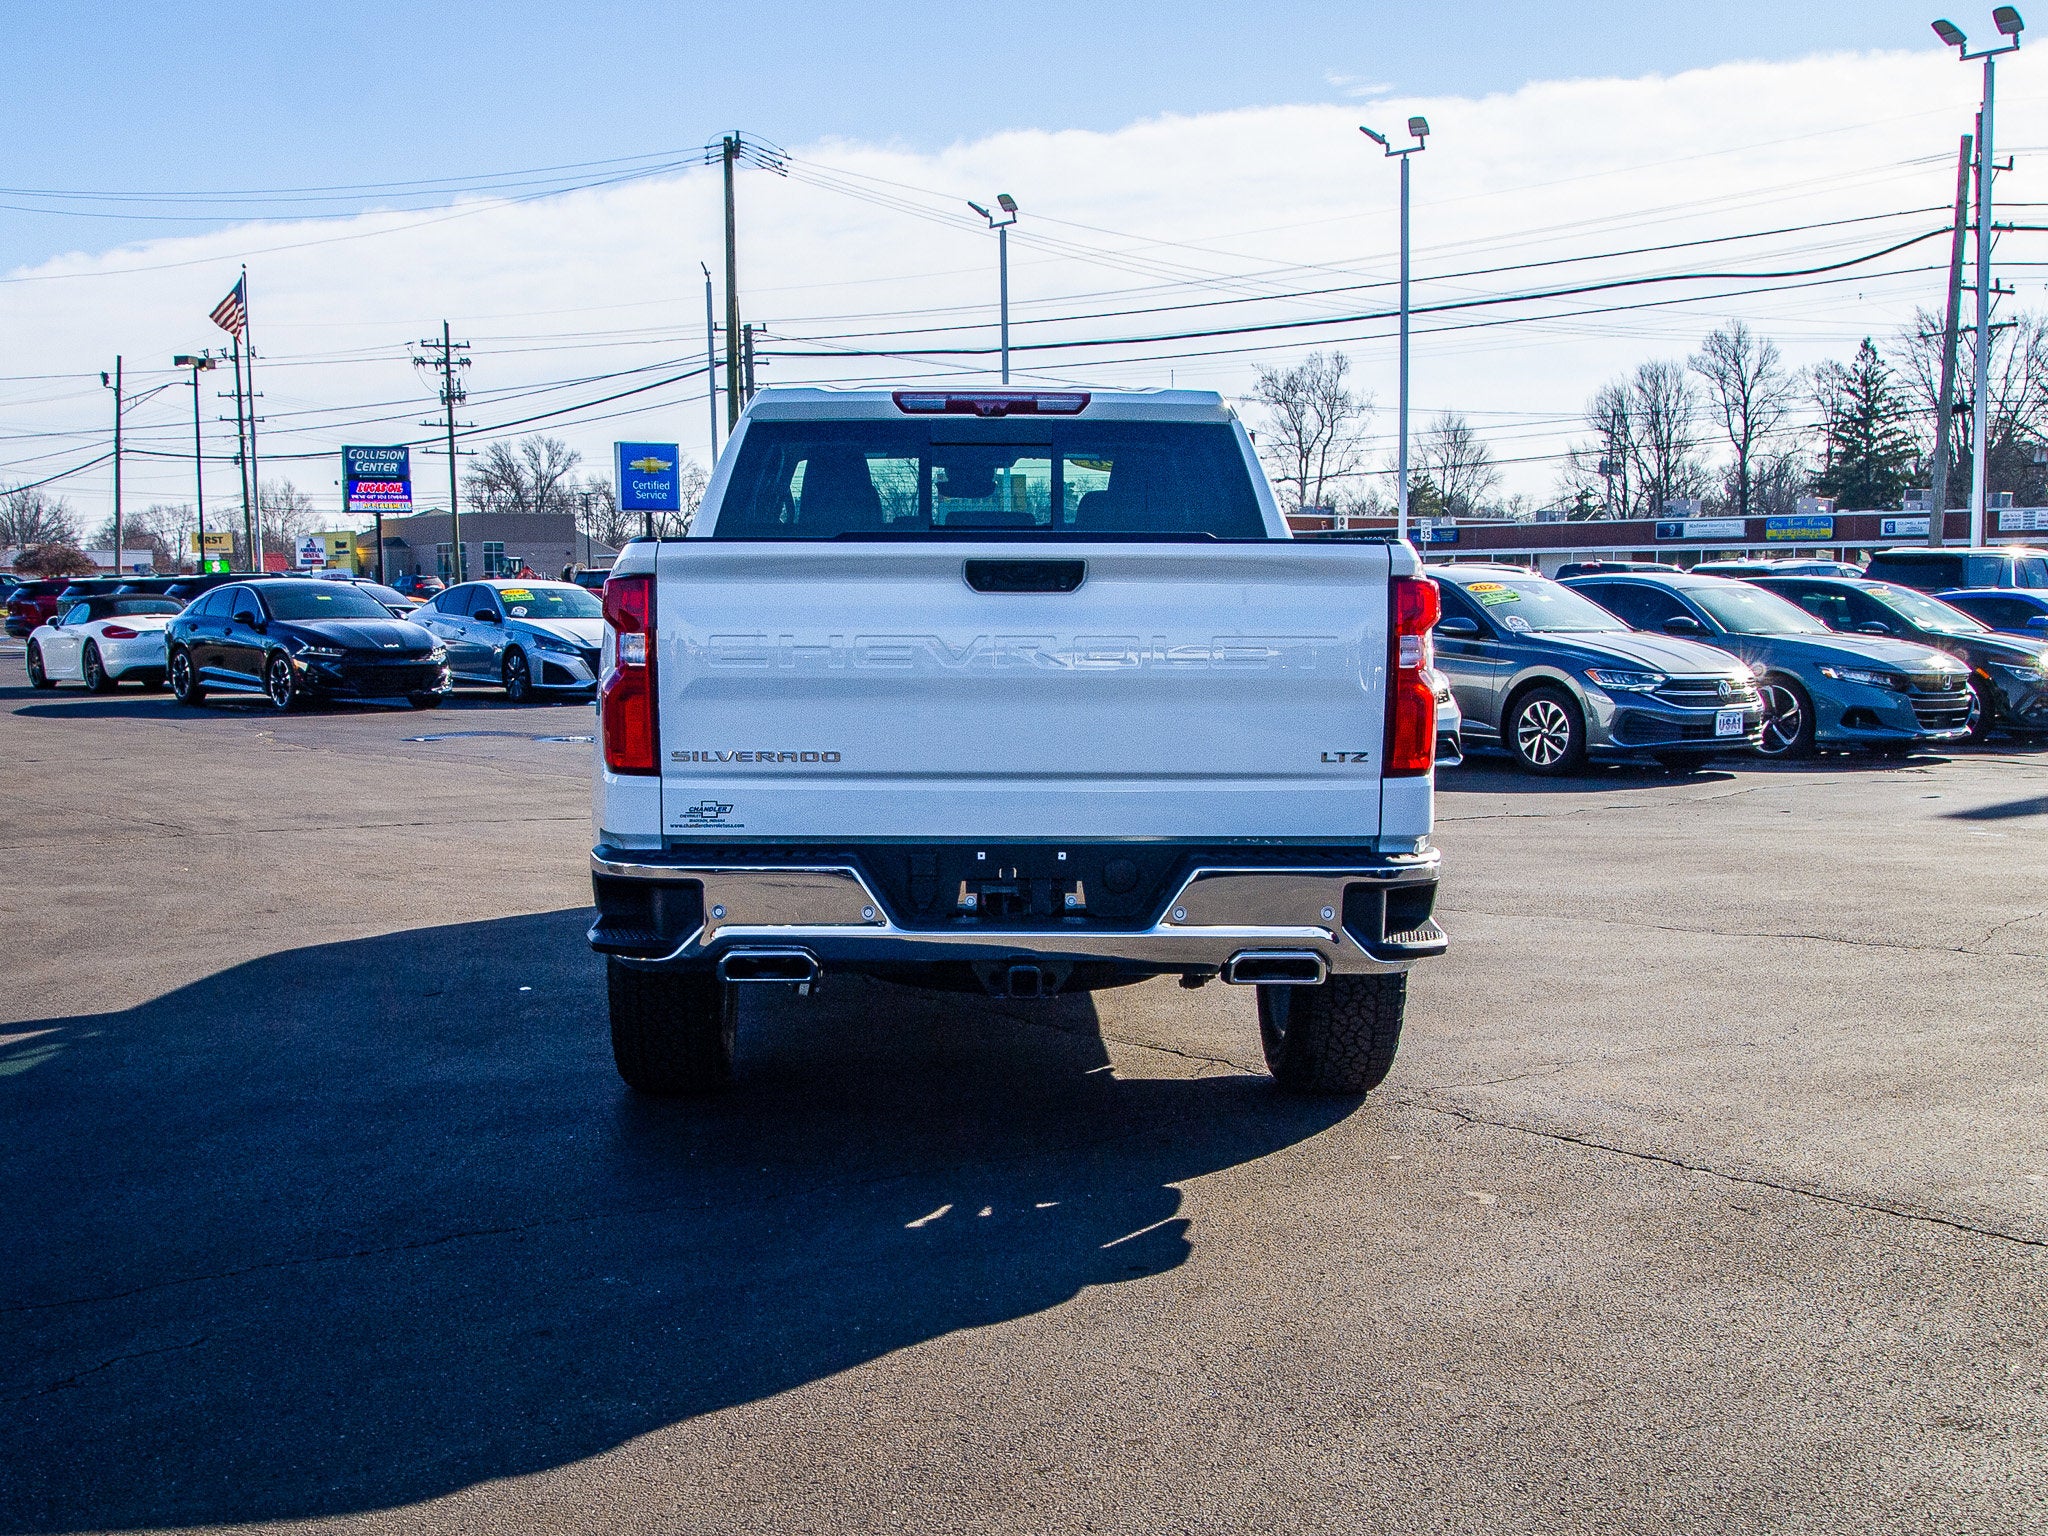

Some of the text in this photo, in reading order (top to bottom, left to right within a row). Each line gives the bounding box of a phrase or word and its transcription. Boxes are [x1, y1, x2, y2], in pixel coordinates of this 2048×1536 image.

[348, 449, 405, 460] COLLISION
[355, 461, 398, 472] CENTER
[632, 480, 670, 490] Certified
[635, 491, 668, 500] Service
[1422, 531, 1431, 540] 35
[708, 634, 1339, 669] CHEVROLET
[671, 750, 841, 762] SILVERADO
[1320, 751, 1369, 763] LTZ
